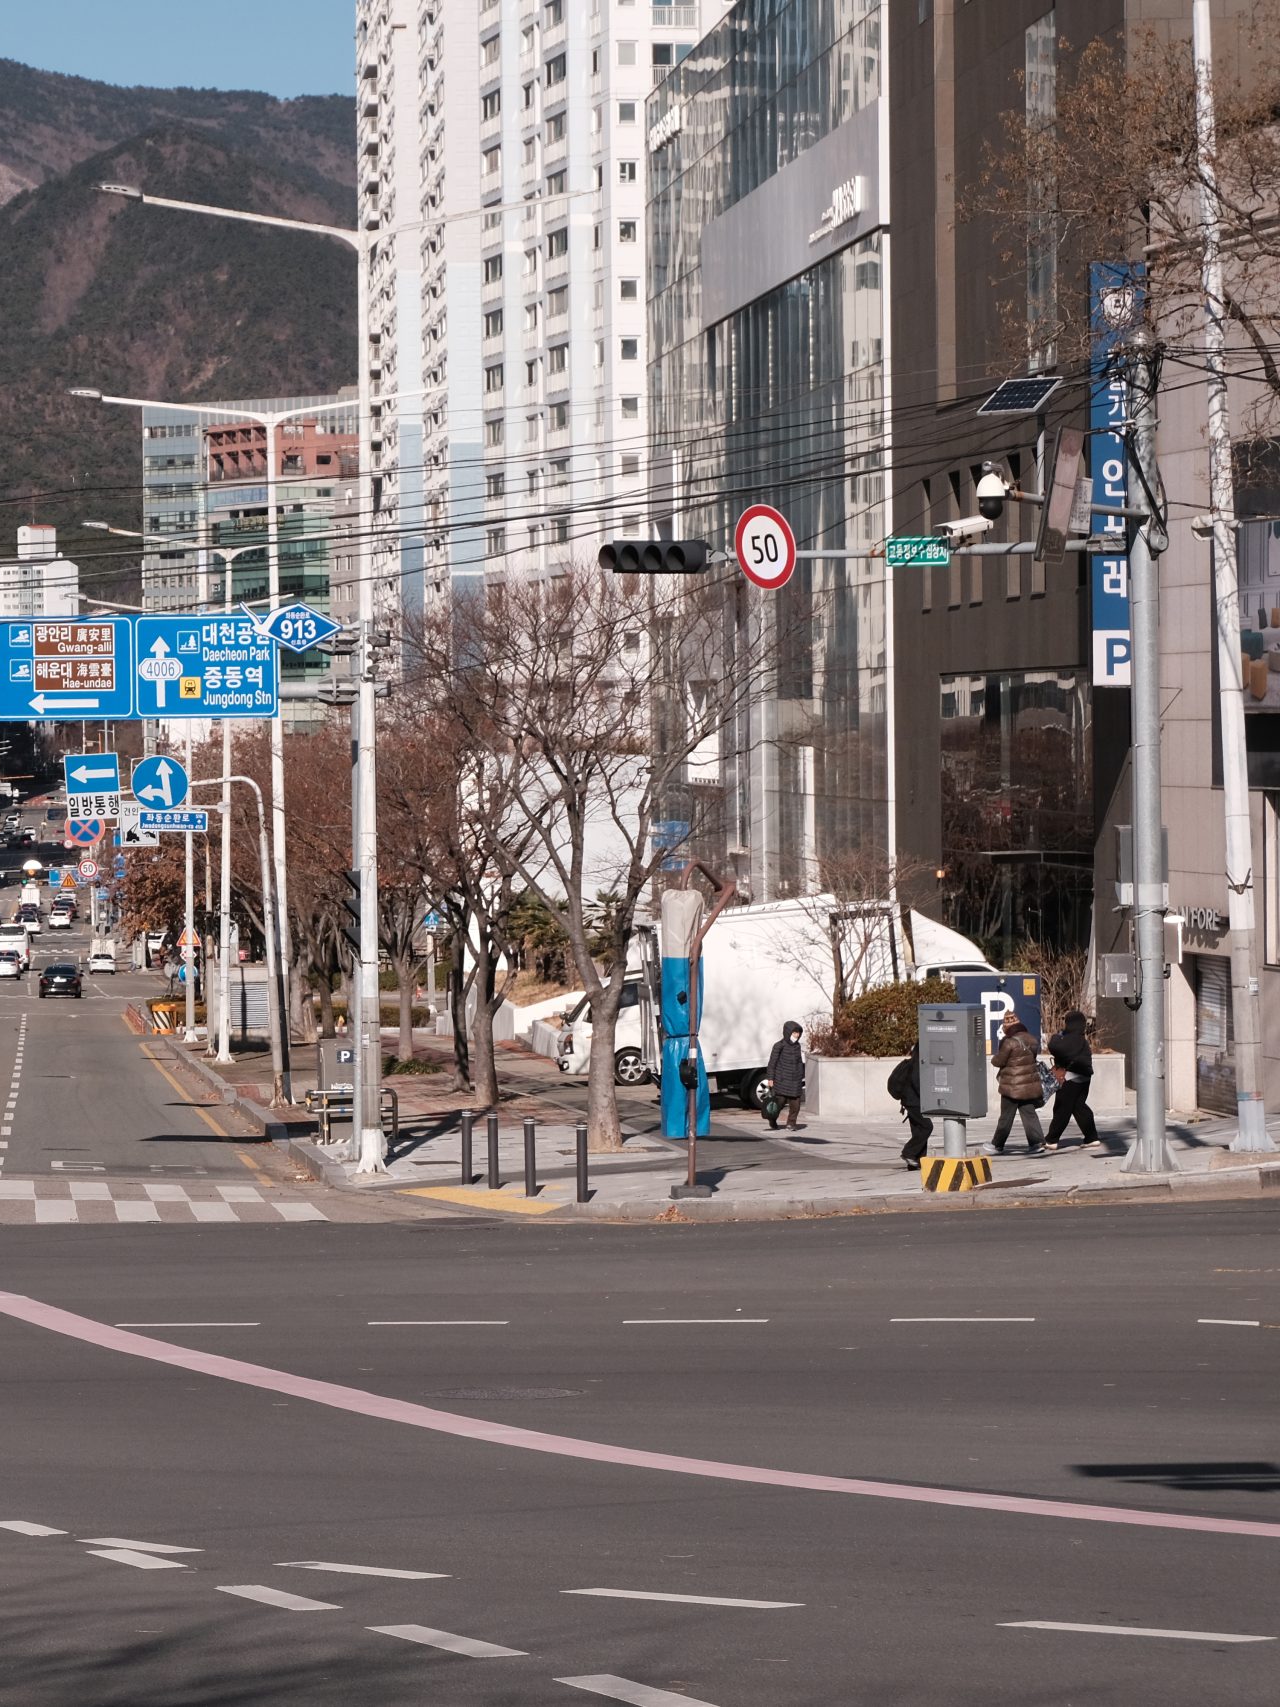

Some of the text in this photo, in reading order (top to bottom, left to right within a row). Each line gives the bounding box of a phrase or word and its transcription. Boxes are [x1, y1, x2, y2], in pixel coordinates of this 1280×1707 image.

[751, 533, 778, 564] 50
[36, 625, 112, 643] 광안리 廣安里
[280, 619, 317, 639] 913
[57, 642, 112, 654] Gwang-alli
[202, 646, 270, 662] Daecheon Park
[1106, 637, 1131, 676] P
[36, 662, 73, 679] 해운대
[146, 663, 175, 677] 4006
[202, 666, 264, 689] 중동역
[62, 677, 112, 689] Hae-undae
[202, 689, 272, 709] Jungdong Stn
[69, 795, 120, 818] 일방통행
[82, 864, 94, 874] 50
[1191, 907, 1220, 931] FORE
[340, 1050, 351, 1063] P
